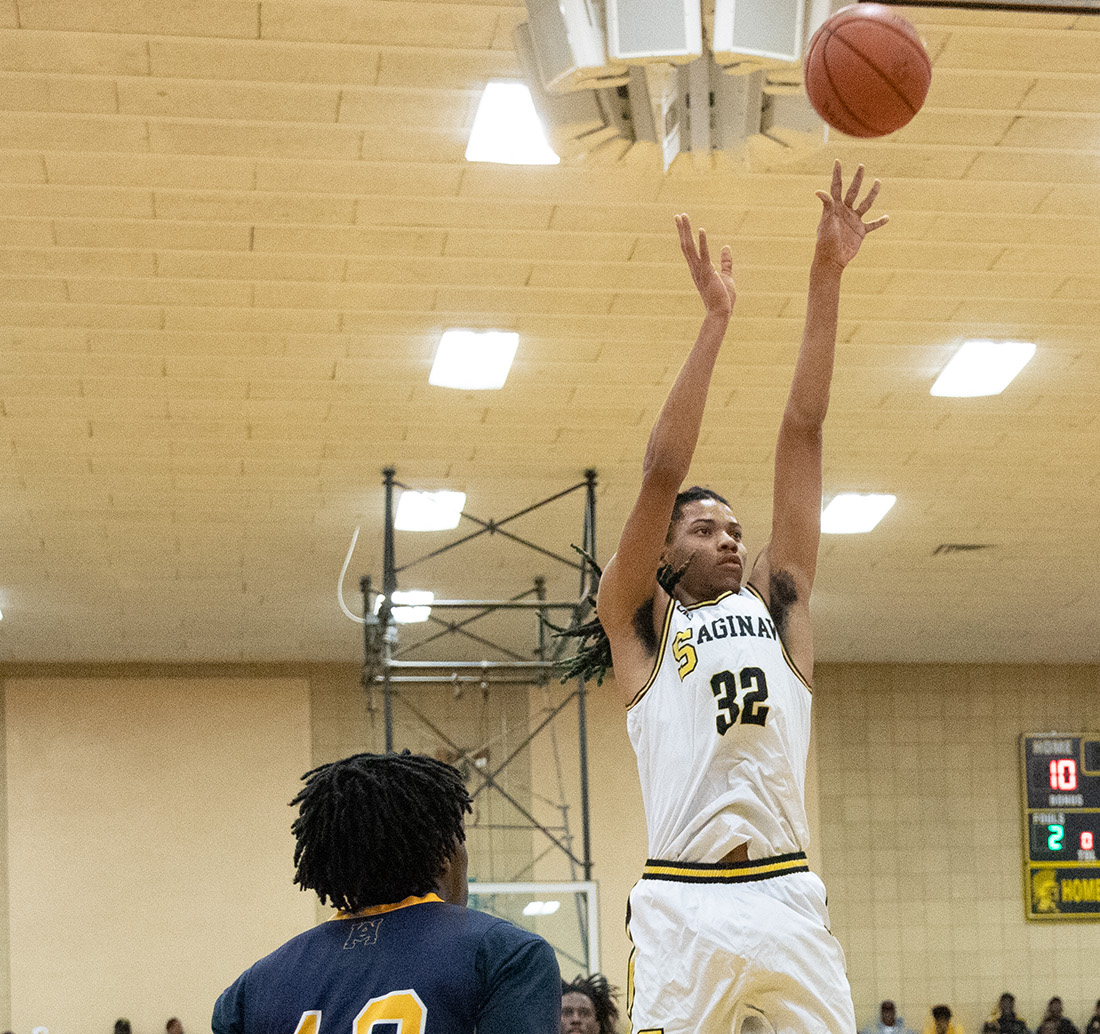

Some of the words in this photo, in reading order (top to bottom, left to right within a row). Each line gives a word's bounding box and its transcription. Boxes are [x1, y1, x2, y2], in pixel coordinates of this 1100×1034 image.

[710, 667, 769, 736] 32
[1049, 759, 1077, 790] 10
[1047, 824, 1064, 851] 2
[1080, 831, 1093, 851] 0
